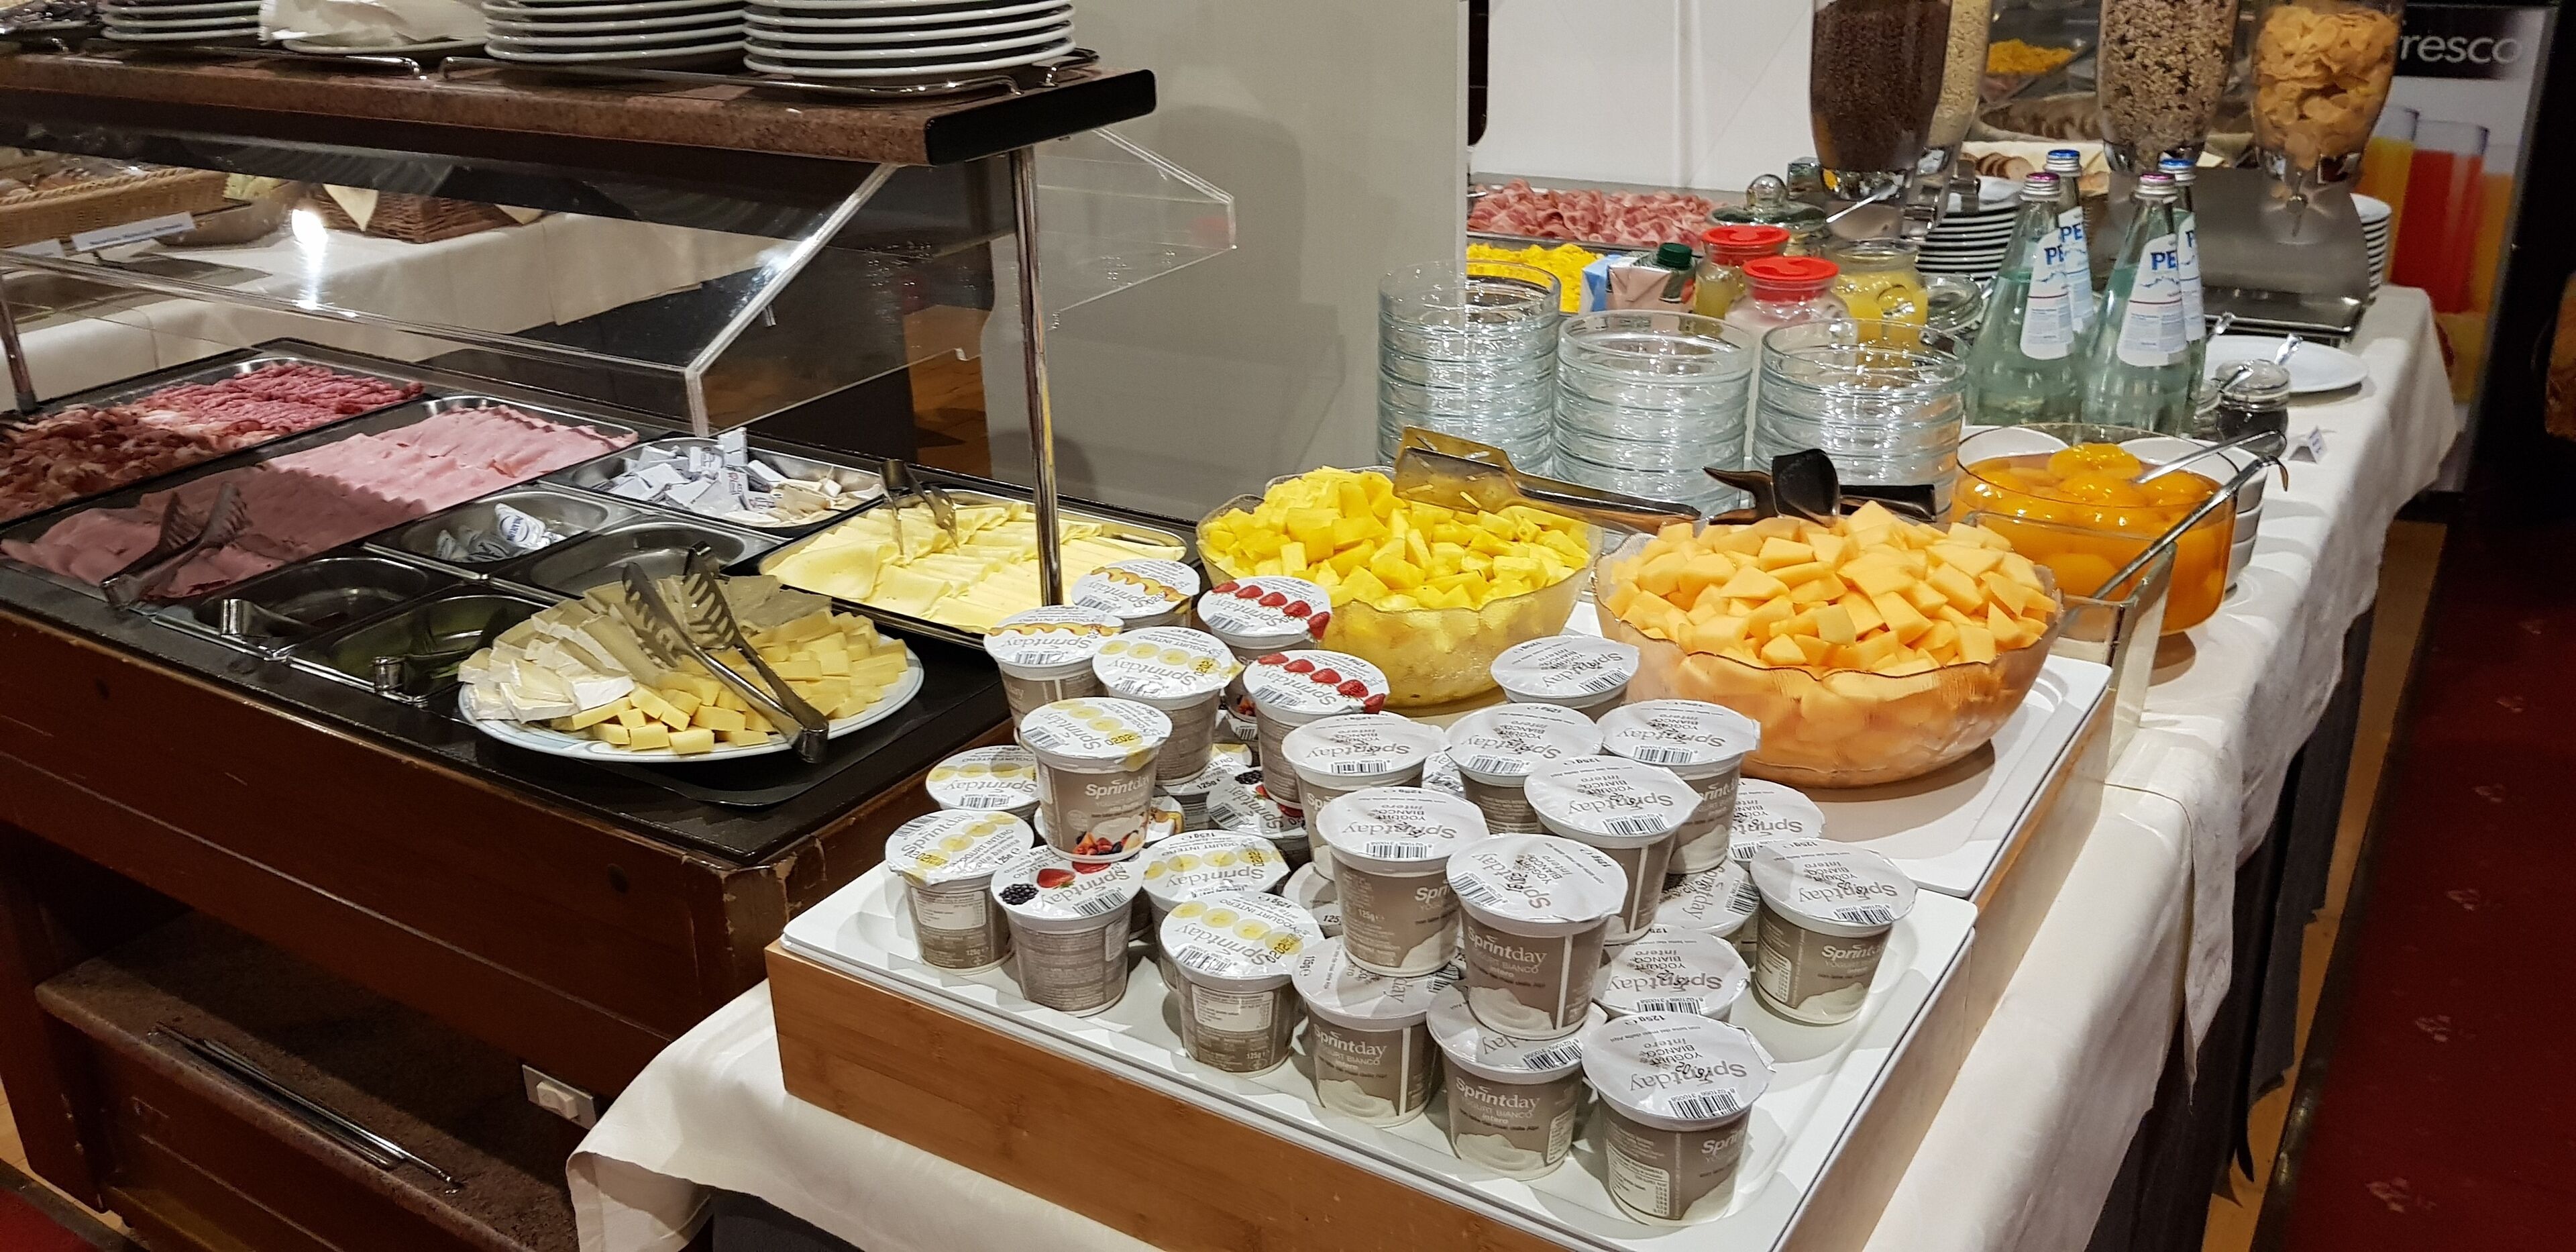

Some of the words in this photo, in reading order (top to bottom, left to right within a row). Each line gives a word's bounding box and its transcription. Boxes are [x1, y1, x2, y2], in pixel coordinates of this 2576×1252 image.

[2400, 36, 2521, 64] resco
[1083, 580, 1148, 609] Sprintday
[1212, 596, 1279, 628] Sprintday
[1001, 633, 1093, 649] Sprintday
[1108, 657, 1197, 686] Sprintday
[1541, 652, 1623, 689] Sprintday
[1258, 667, 1337, 707] Sprintday
[1039, 711, 1102, 751] Sprintday
[1616, 727, 1726, 747] Sprintday
[1305, 743, 1411, 759] Sprintday
[1461, 735, 1562, 760] Sprintday
[943, 779, 1038, 794] Sprintday
[1224, 784, 1283, 830] Sprintday
[1566, 792, 1674, 815] Sprintday
[901, 812, 975, 857] Sprintday
[1341, 821, 1458, 839] Sprintday
[1730, 819, 1803, 836] Sprint
[1040, 870, 1130, 908] Sprintday
[1165, 866, 1266, 888] Sprintday
[1471, 852, 1552, 910] Sprintday
[1797, 882, 1898, 902] Sprintday
[1219, 898, 1256, 915] INTERO
[1322, 915, 1342, 924] 125
[1175, 922, 1271, 967] Sprintday
[1466, 926, 1548, 968] Sprintday
[1605, 973, 1723, 992] Sprintday
[1313, 1023, 1387, 1059] Sprintday
[1644, 1037, 1687, 1049] intero
[1646, 1044, 1695, 1059] BIANCO
[1629, 1060, 1748, 1092] Sprintday
[1455, 1076, 1541, 1112] Sprintday
